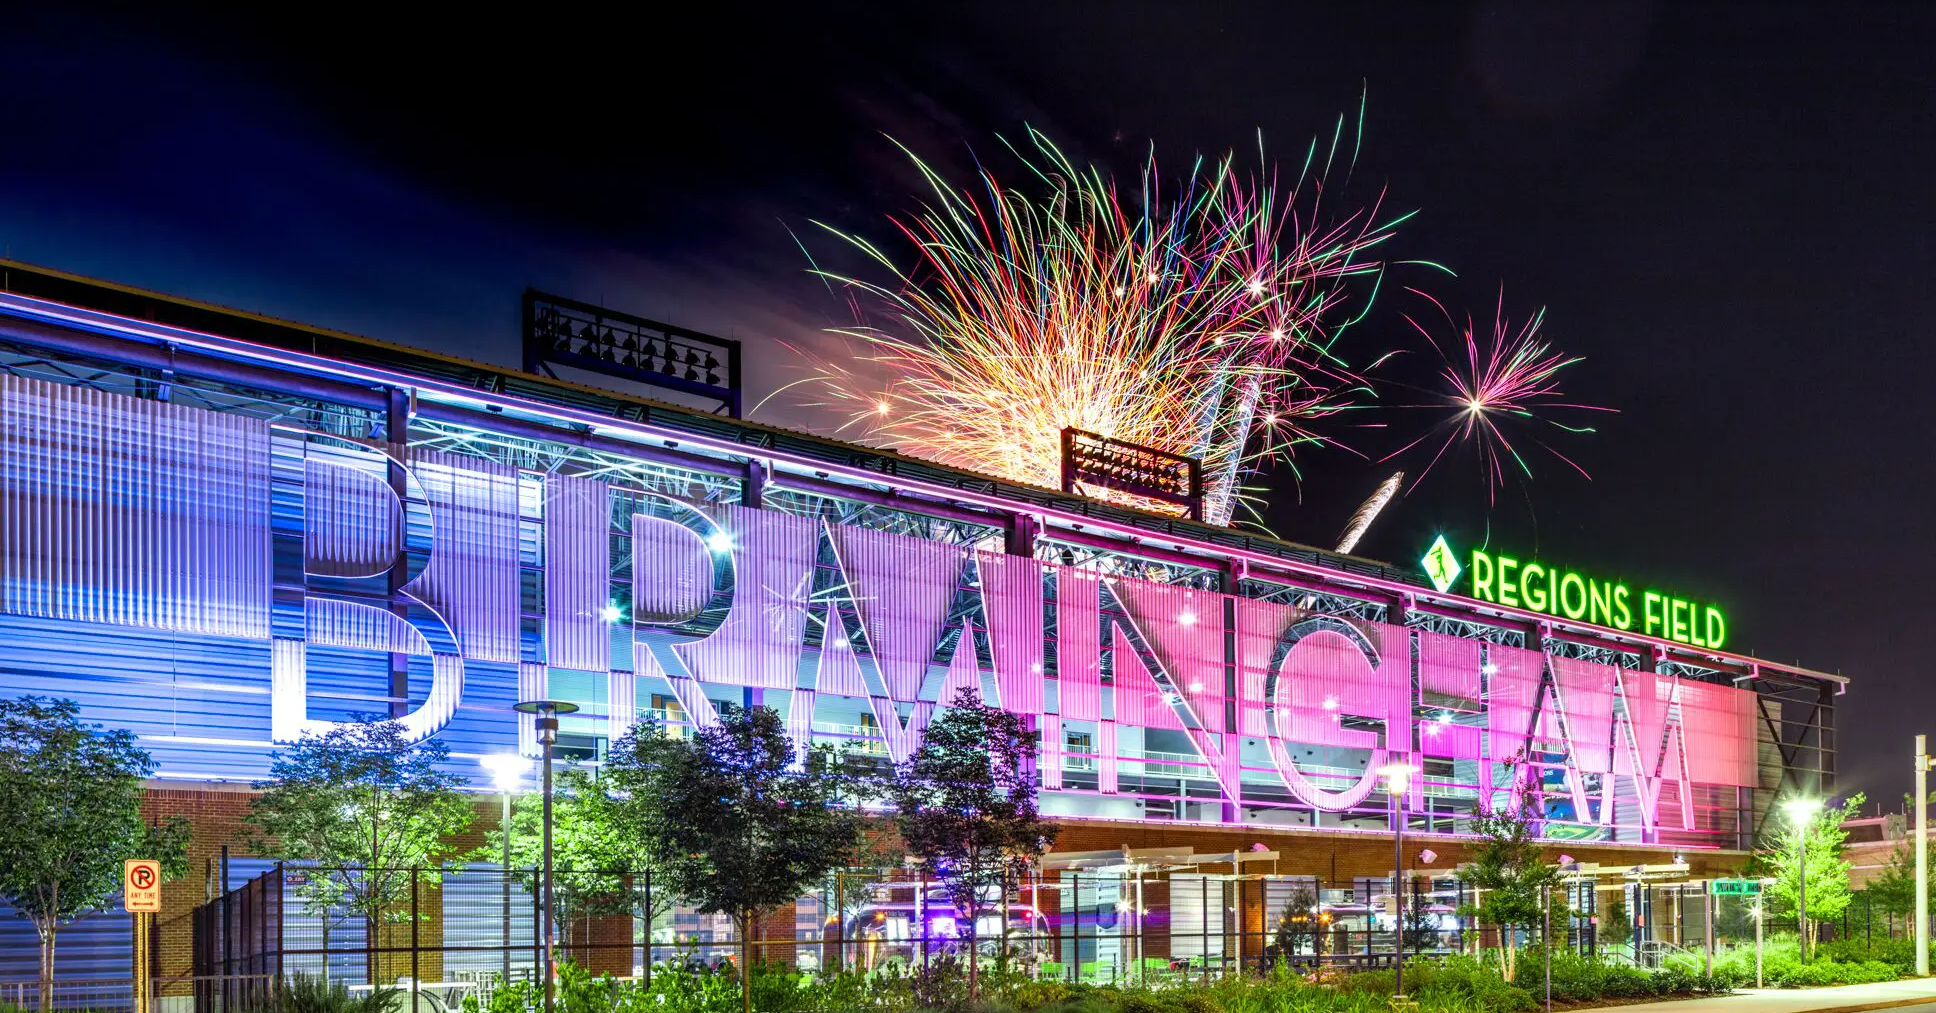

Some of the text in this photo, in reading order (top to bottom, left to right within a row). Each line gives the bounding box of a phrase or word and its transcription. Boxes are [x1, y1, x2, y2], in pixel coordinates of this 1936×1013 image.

[271, 424, 1696, 834] BIRMINGHAM
[1472, 549, 1726, 649] REGIONS FIELD
[138, 869, 151, 885] P
